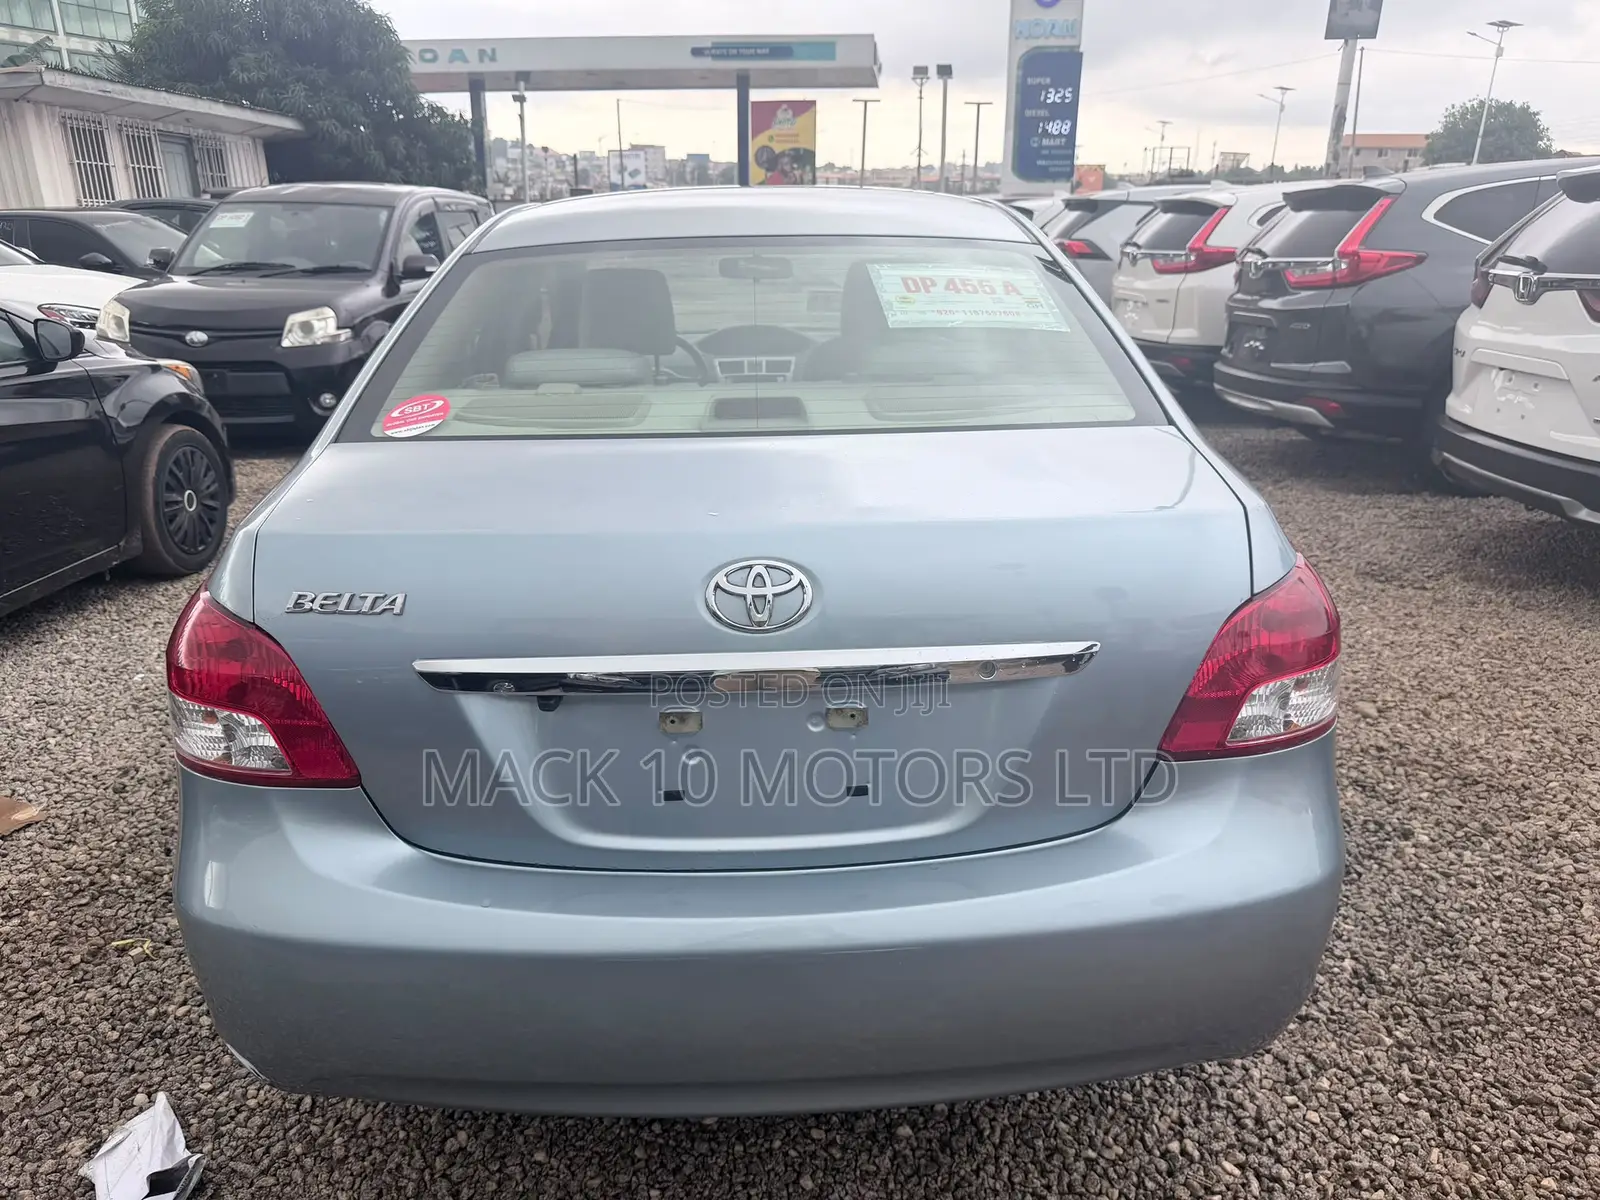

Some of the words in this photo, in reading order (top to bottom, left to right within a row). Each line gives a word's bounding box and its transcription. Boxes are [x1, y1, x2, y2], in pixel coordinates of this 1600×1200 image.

[1040, 87, 1073, 104] 1325
[1038, 119, 1072, 136] 1488
[901, 276, 938, 294] DP
[944, 277, 997, 296] 455
[1003, 280, 1024, 297] A
[404, 403, 431, 414] SBT
[285, 591, 407, 616] BELTA
